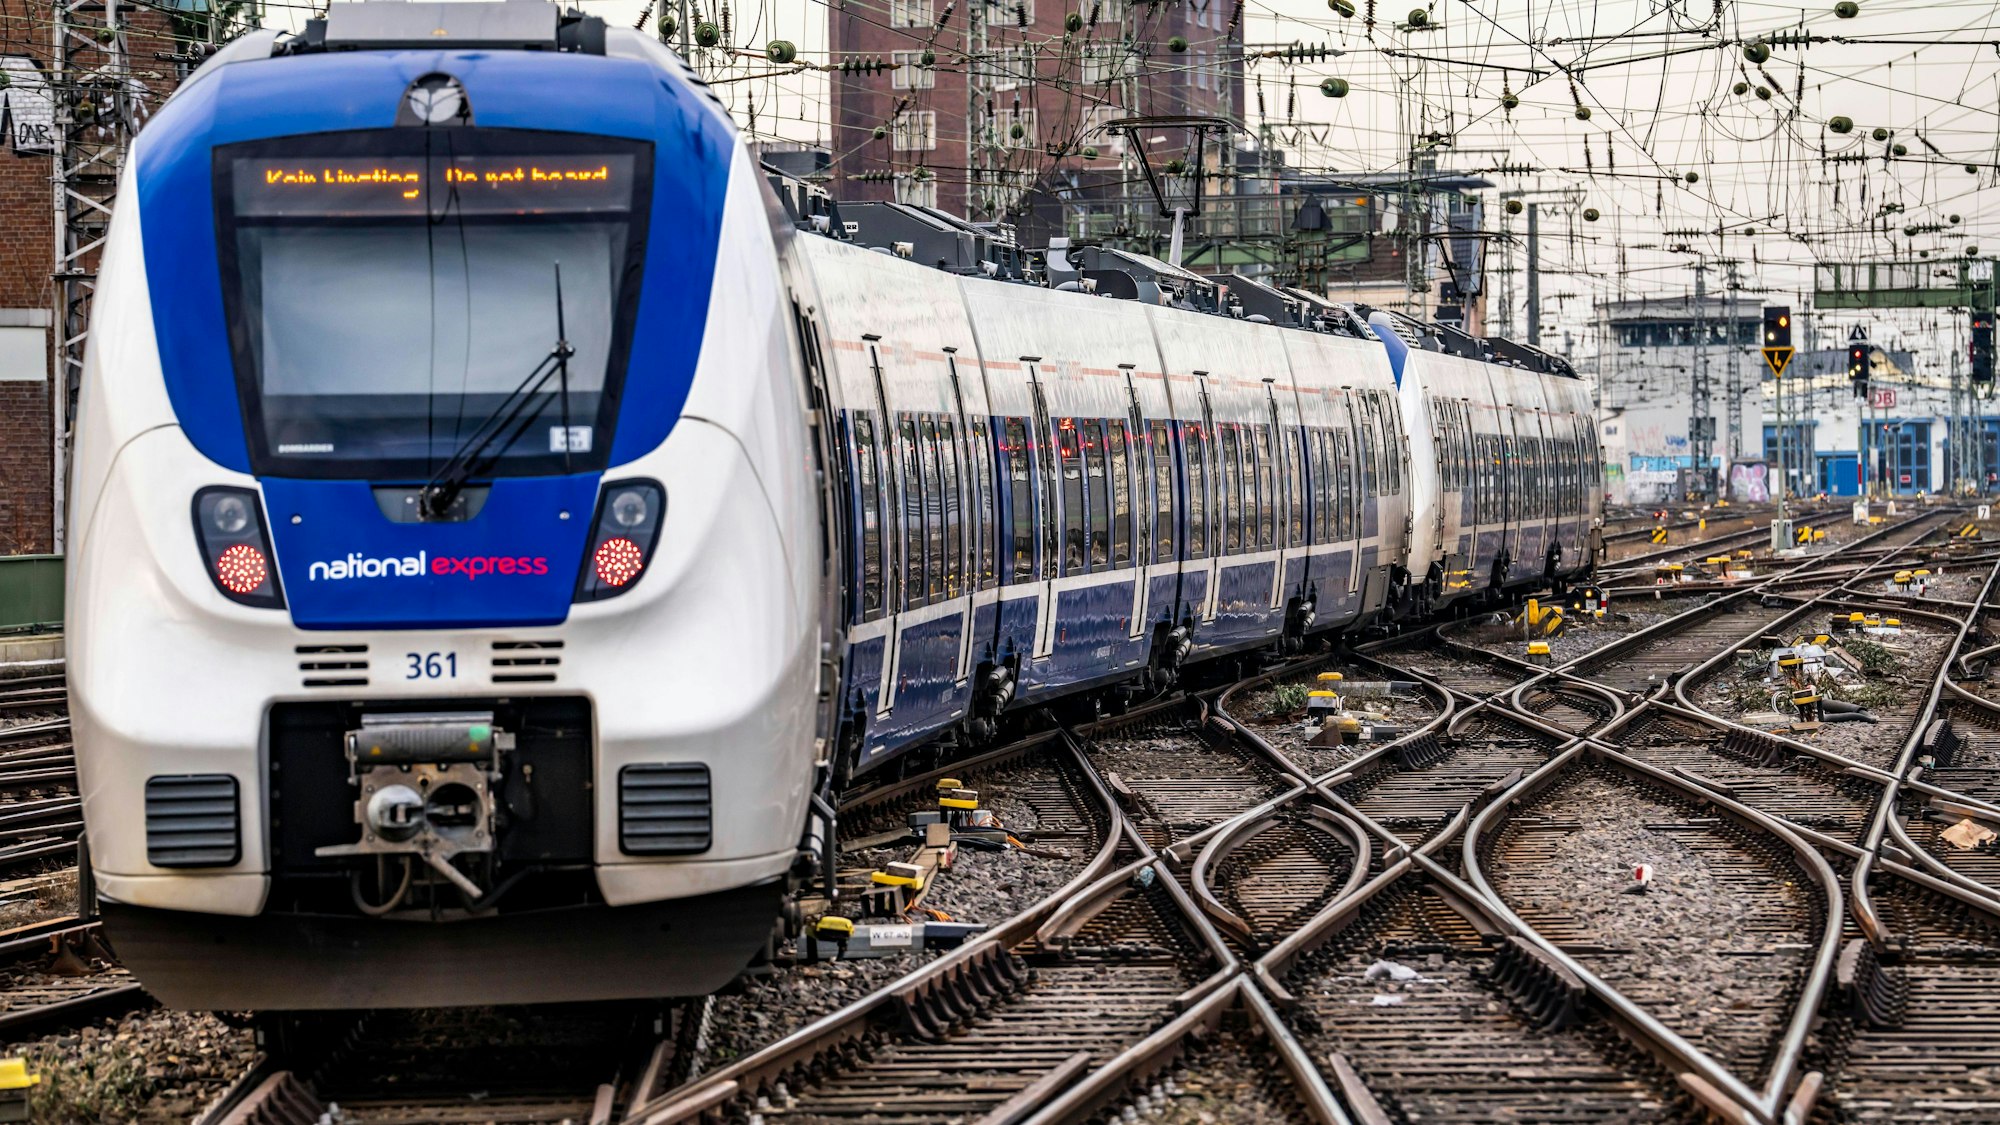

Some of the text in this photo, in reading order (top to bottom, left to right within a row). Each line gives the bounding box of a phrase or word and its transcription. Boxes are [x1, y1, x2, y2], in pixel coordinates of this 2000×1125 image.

[1774, 351, 1782, 367] 4
[309, 550, 549, 581] national express
[406, 651, 457, 679] 361
